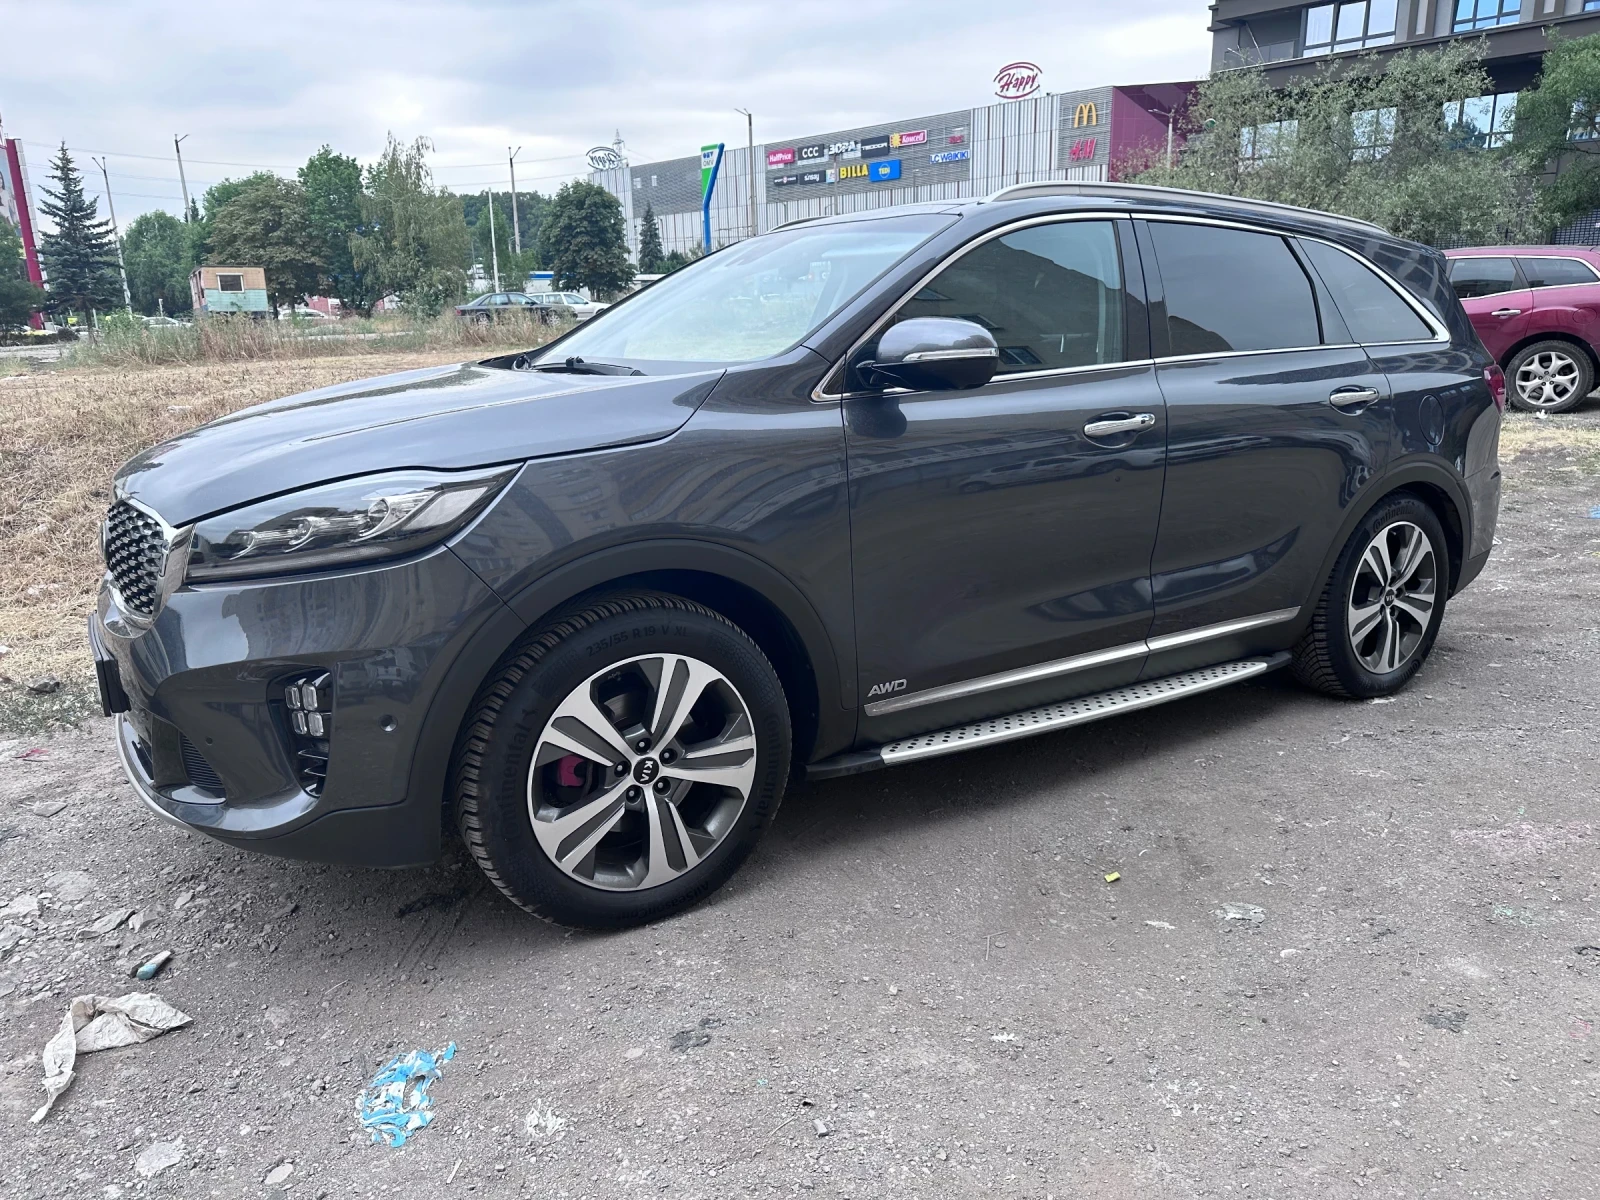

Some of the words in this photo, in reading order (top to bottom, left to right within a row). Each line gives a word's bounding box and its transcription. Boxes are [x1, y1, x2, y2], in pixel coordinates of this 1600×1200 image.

[998, 71, 1039, 93] Happy
[769, 152, 792, 163] HalfPrice
[802, 146, 819, 158] CCC
[930, 155, 940, 164] LC
[1069, 138, 1097, 161] H&M
[840, 163, 869, 179] BILLA
[586, 631, 629, 657] 235/55
[631, 628, 641, 639] R
[644, 625, 656, 637] 19
[661, 624, 670, 636] V
[866, 678, 908, 698] AWD
[640, 760, 654, 782] KIA
[600, 880, 710, 921] AllSeasonCont
